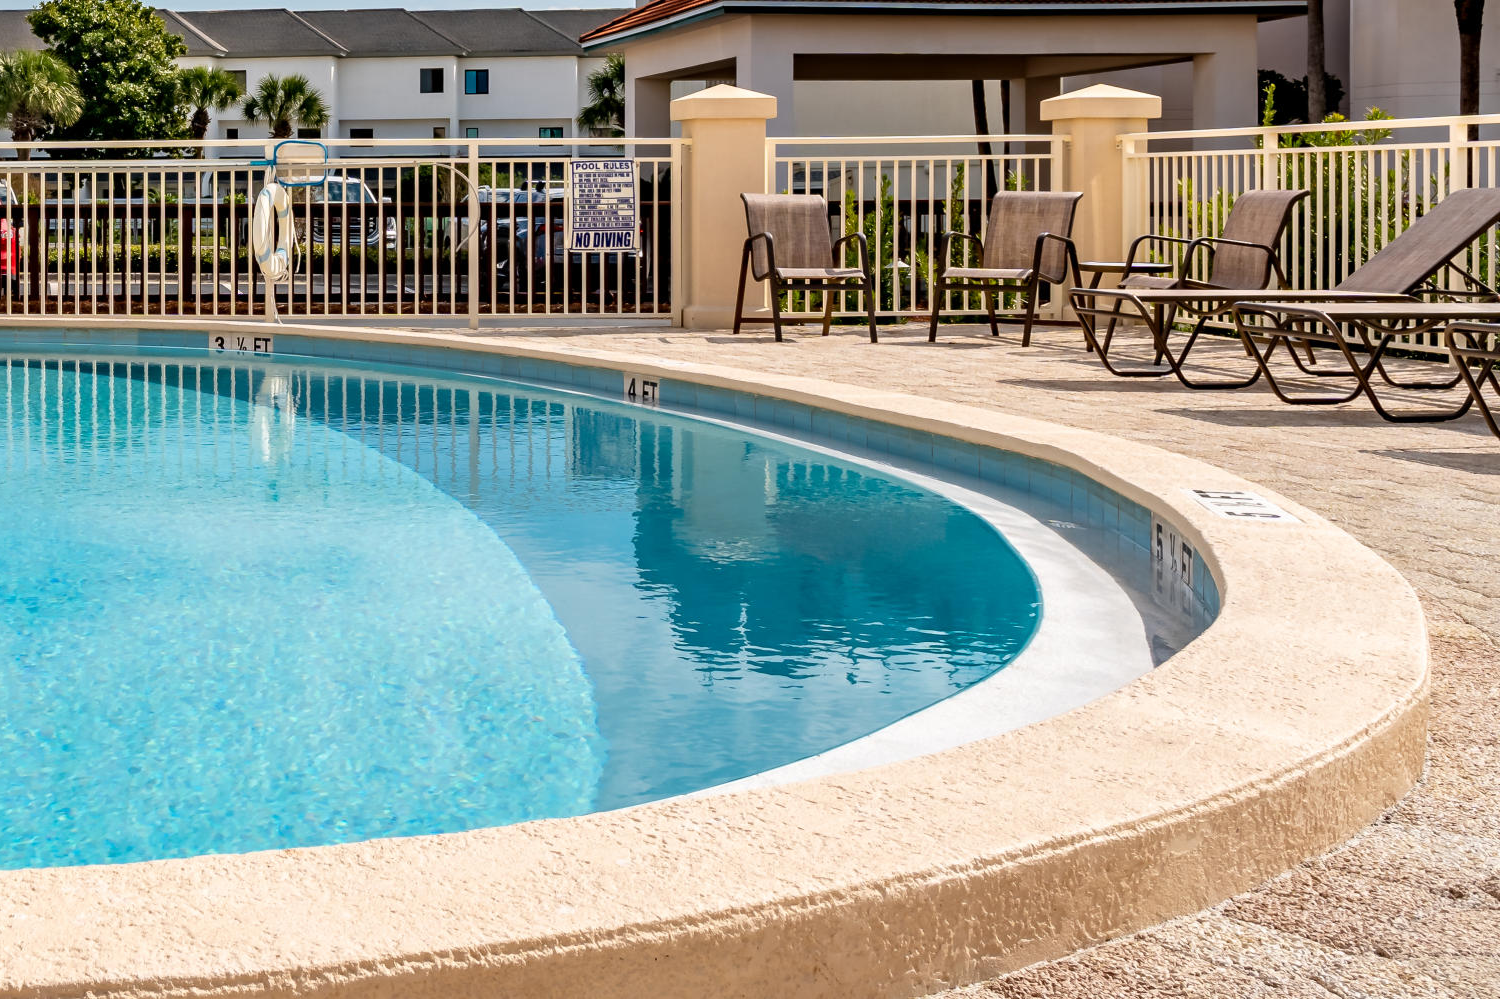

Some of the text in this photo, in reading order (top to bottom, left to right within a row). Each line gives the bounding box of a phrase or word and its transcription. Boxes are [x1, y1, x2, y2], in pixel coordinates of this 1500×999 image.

[575, 162, 630, 171] POOL RULES
[575, 231, 631, 248] NO DIVING
[214, 336, 225, 350] 3
[253, 337, 272, 353] FT
[628, 377, 658, 401] 4 FT
[1156, 522, 1164, 561] 5
[1181, 541, 1193, 585] FT
